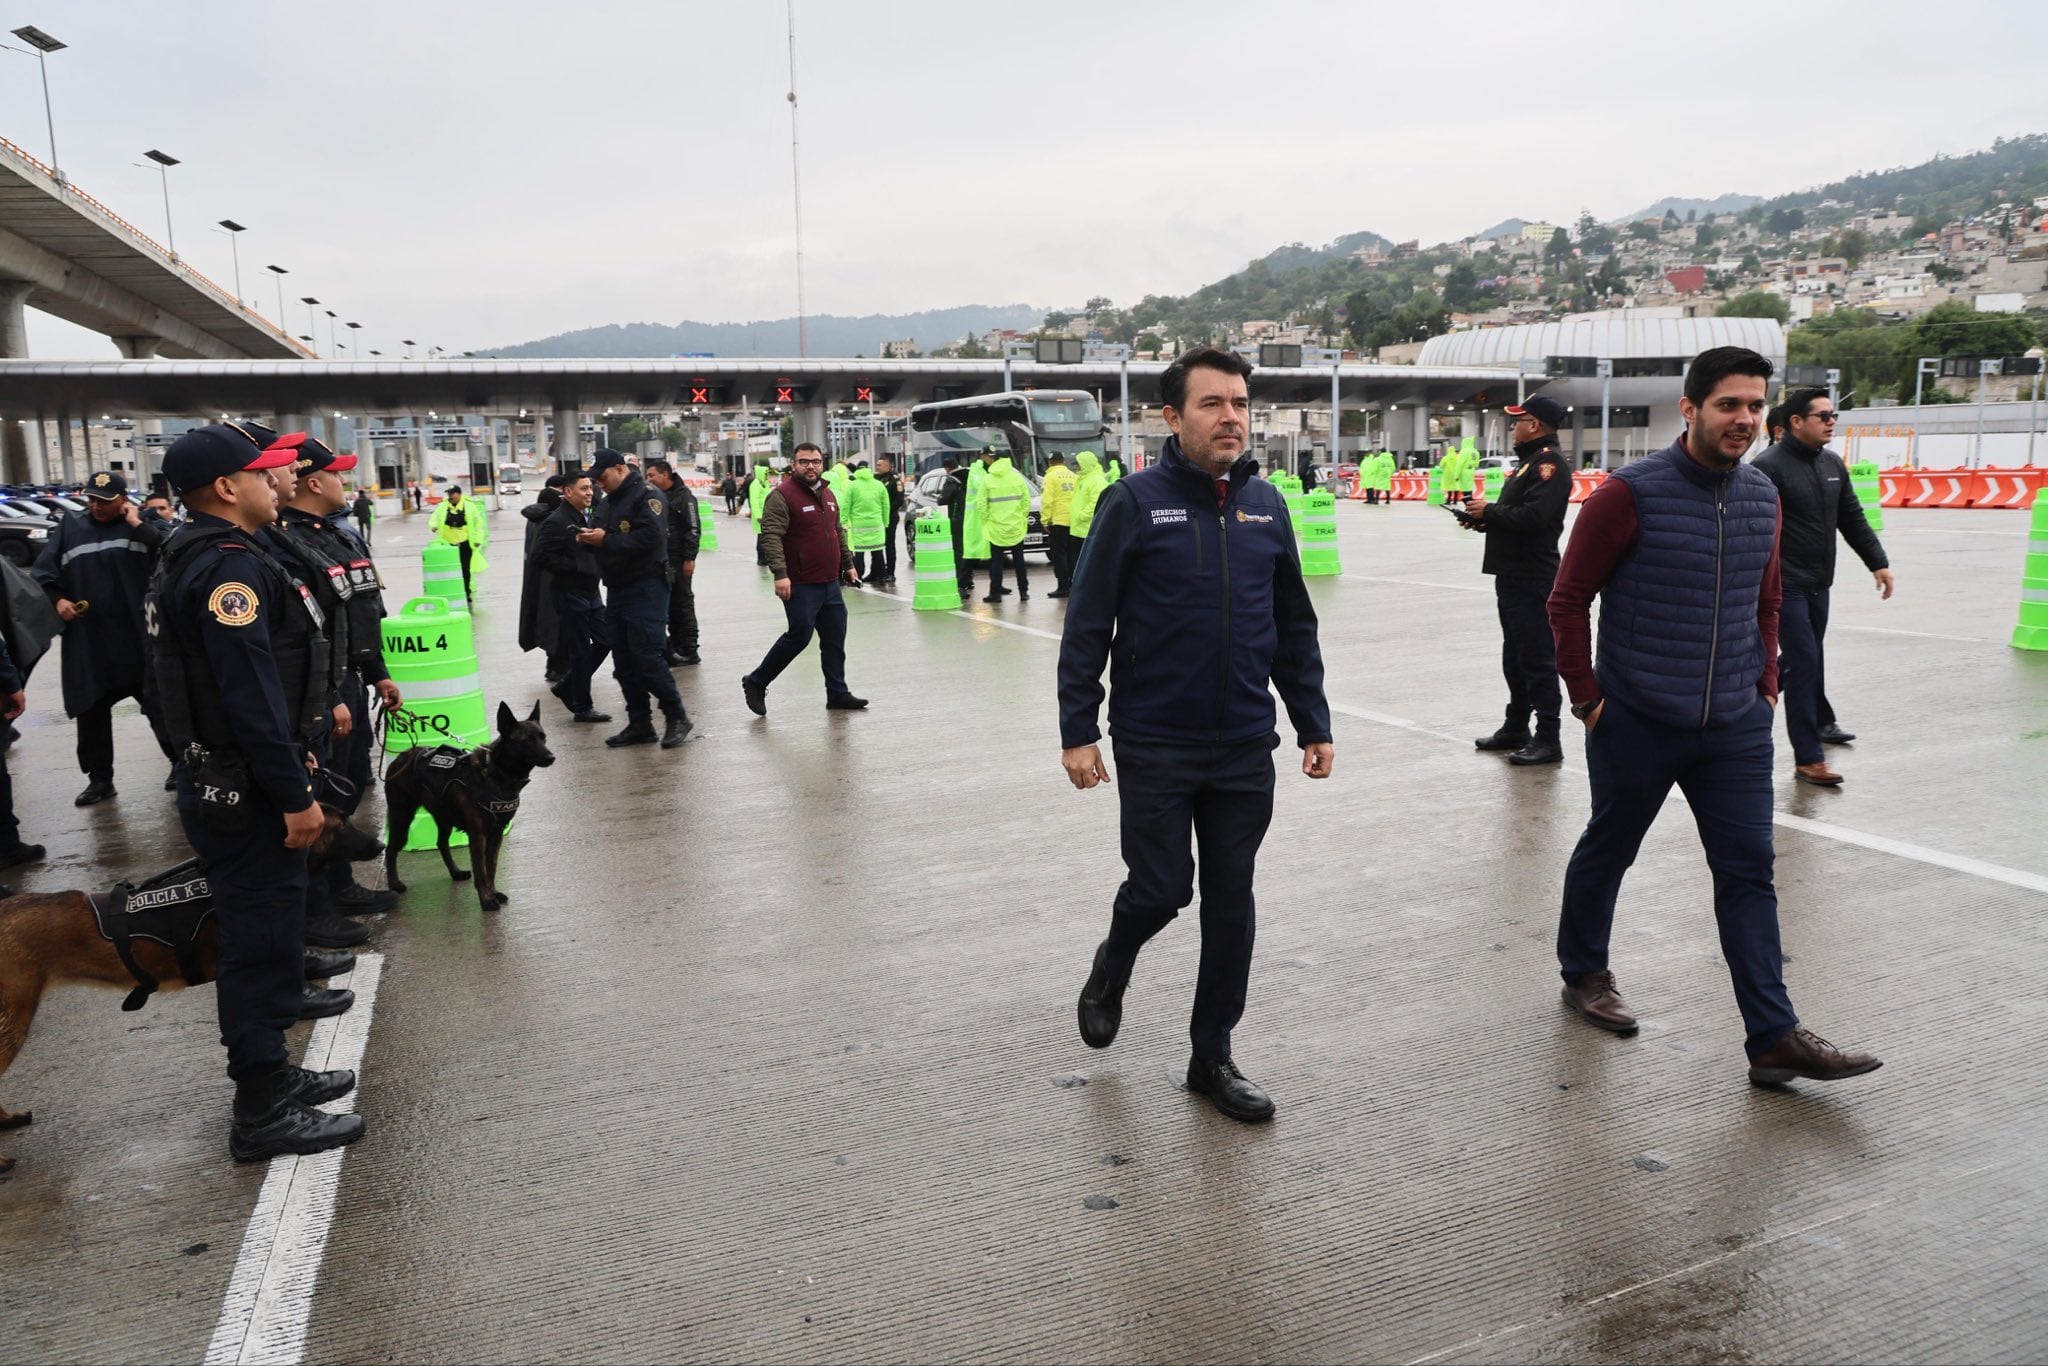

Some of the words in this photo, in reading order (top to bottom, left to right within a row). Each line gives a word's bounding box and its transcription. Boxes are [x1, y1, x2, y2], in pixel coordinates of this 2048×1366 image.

[1151, 509, 1187, 517] DERECHOS
[1152, 515, 1188, 525] HUMANOS
[935, 524, 941, 533] 4
[386, 635, 430, 653] VIAL
[435, 633, 448, 650] 4
[202, 785, 240, 805] K-9
[129, 888, 180, 911] POLICIA
[184, 881, 209, 898] K-9
